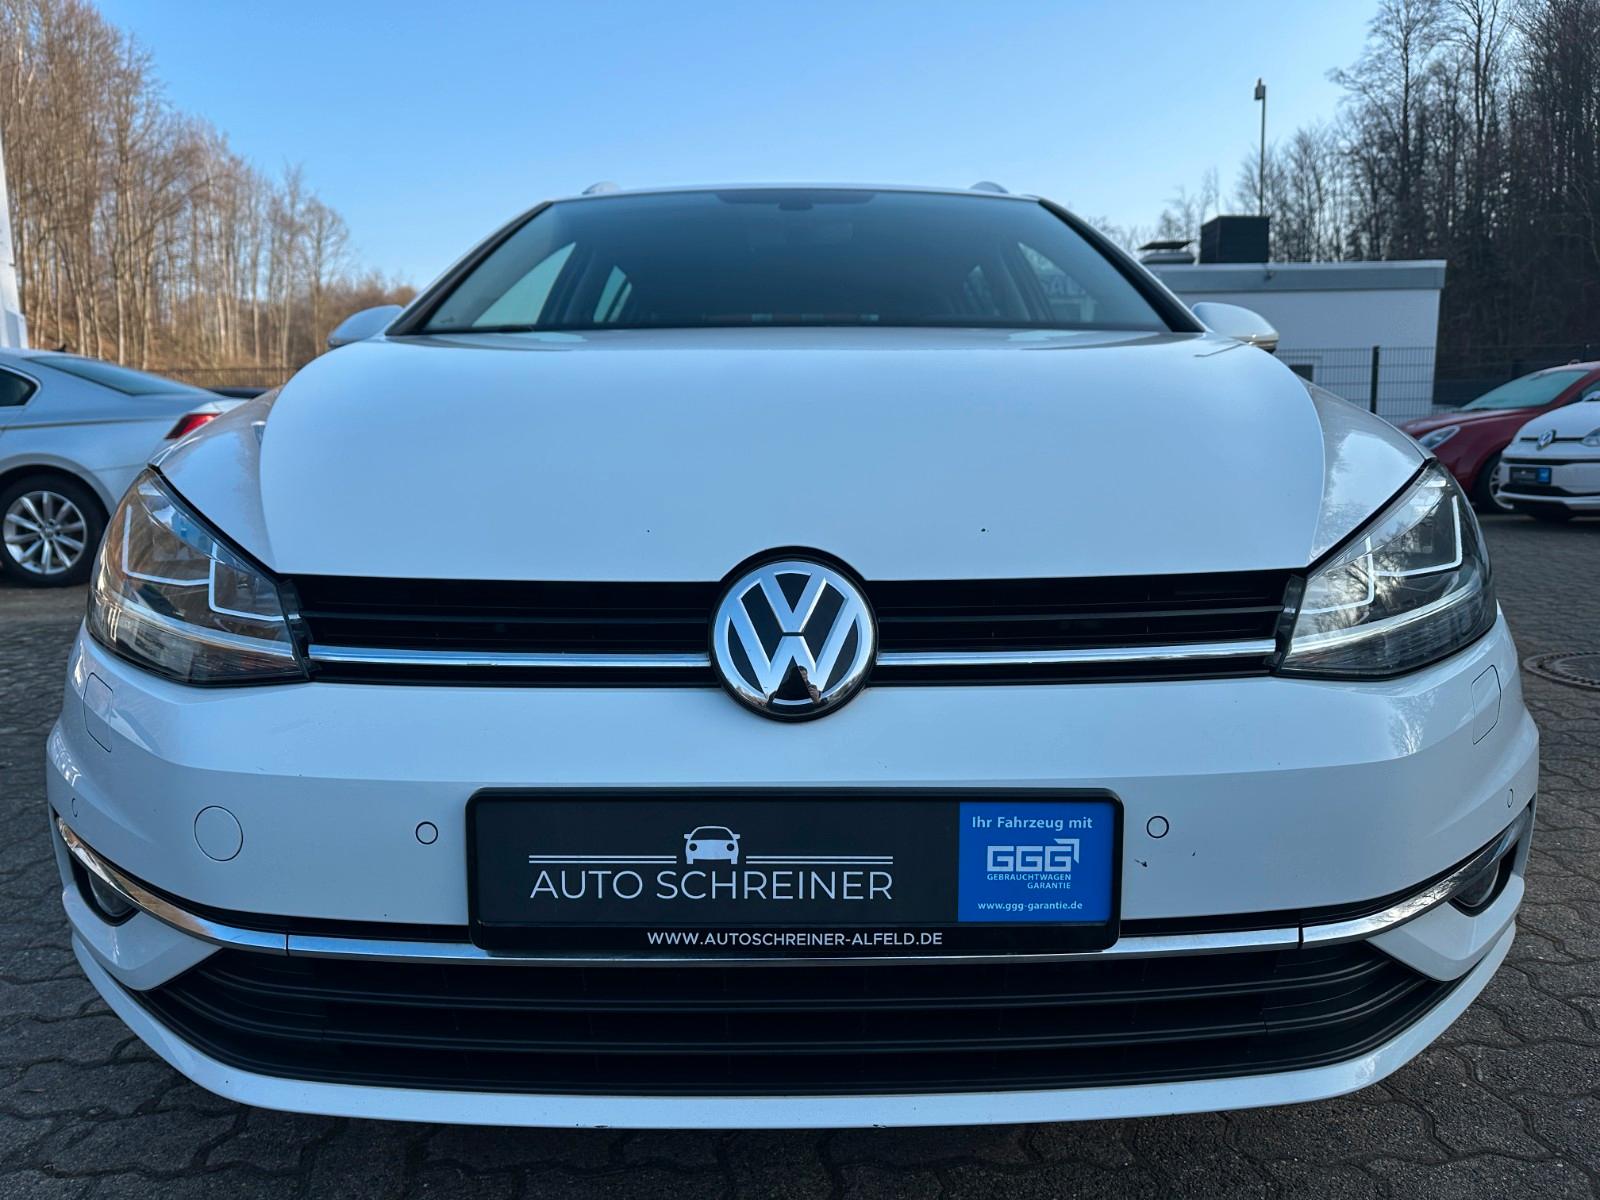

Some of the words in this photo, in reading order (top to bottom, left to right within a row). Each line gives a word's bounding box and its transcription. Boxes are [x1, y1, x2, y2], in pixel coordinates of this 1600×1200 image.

[972, 816, 992, 828] Ihr
[997, 816, 1064, 831] Fahrzeug
[1068, 816, 1093, 829] mit
[987, 845, 1072, 872] GGG
[987, 873, 1072, 881] GEBRAUCHTWAGEN
[530, 870, 643, 900] AUTO
[656, 870, 893, 900] SCHREINER
[977, 901, 1083, 912] www.ggg-garantie.de
[647, 932, 943, 946] WWW.AUTOSCHREINER-ALFELD.DE
